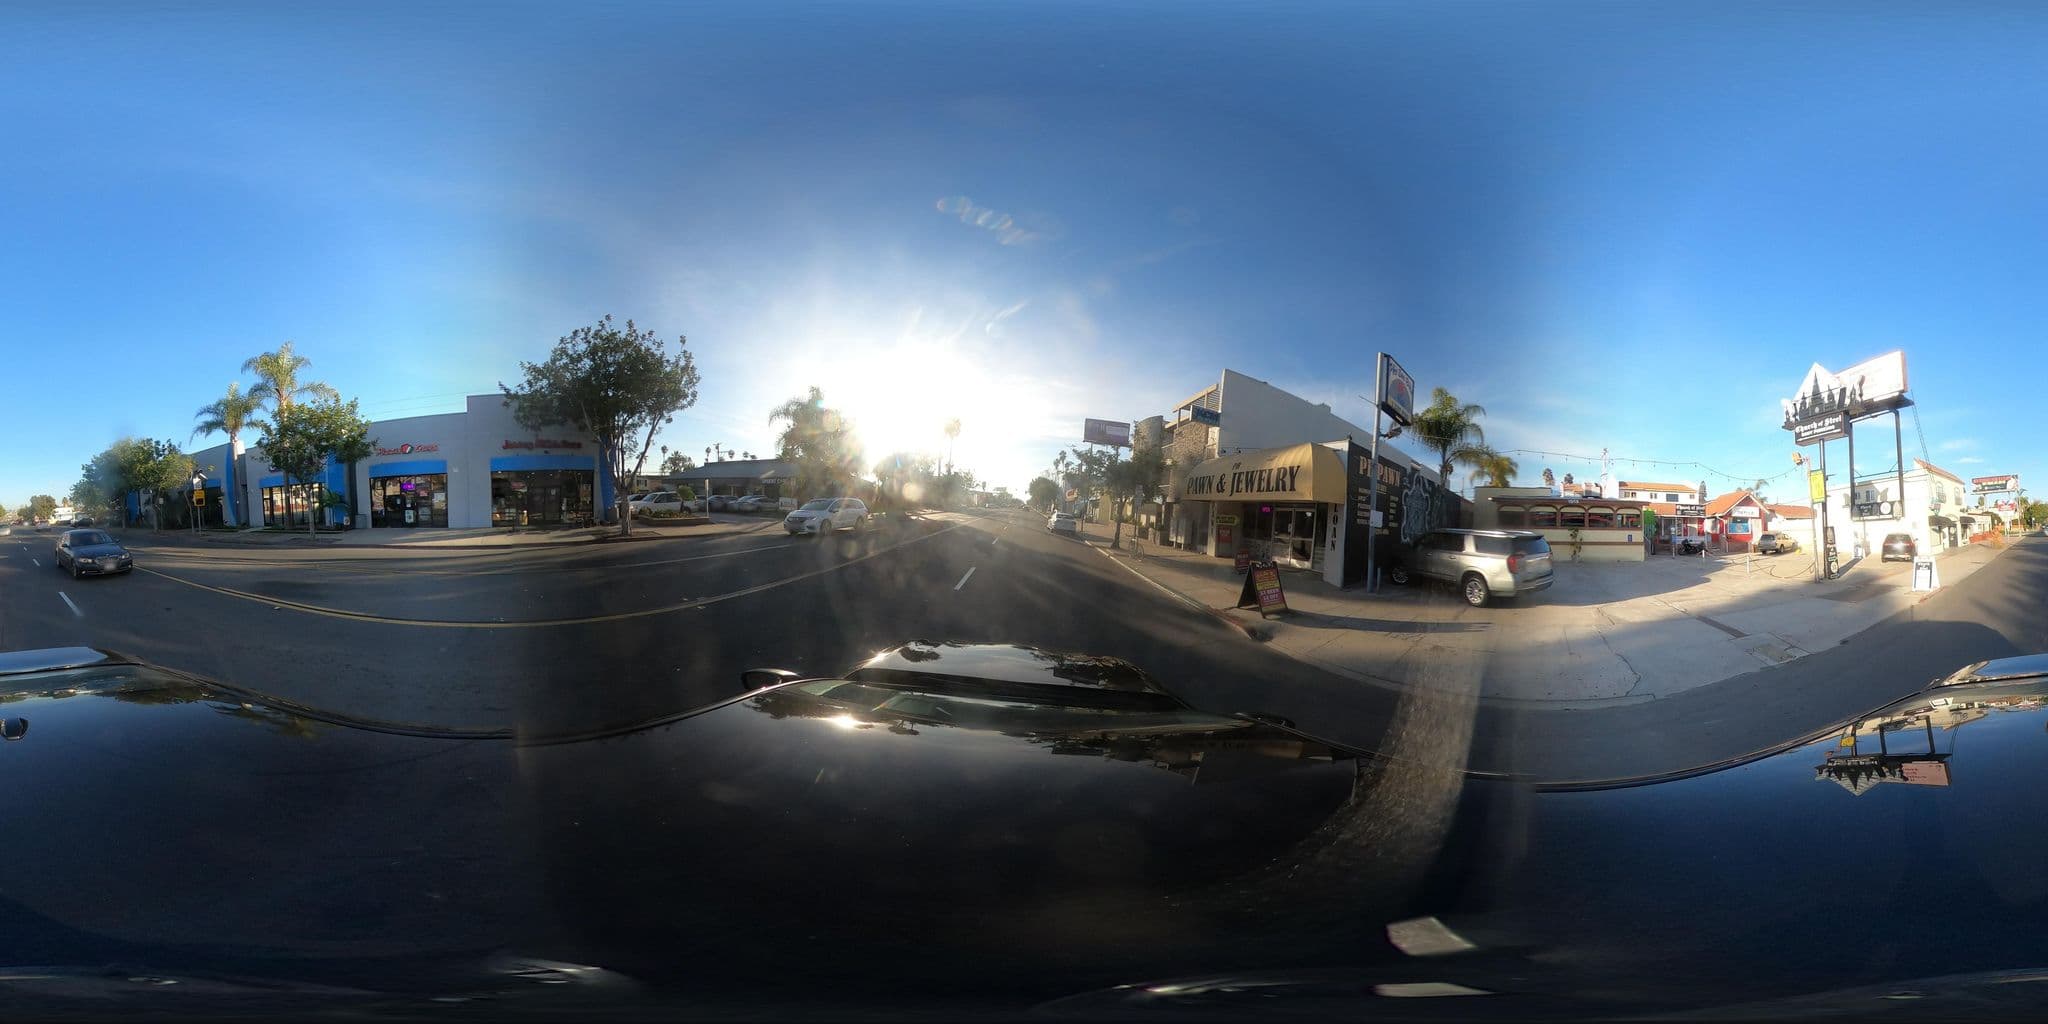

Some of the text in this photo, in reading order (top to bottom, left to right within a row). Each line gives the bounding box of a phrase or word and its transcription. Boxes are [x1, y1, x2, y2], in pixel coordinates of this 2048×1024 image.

[1186, 465, 1301, 497] PAWN & JEWELRY
[1377, 462, 1401, 487] PAWN
[1330, 503, 1338, 551] LOAN
